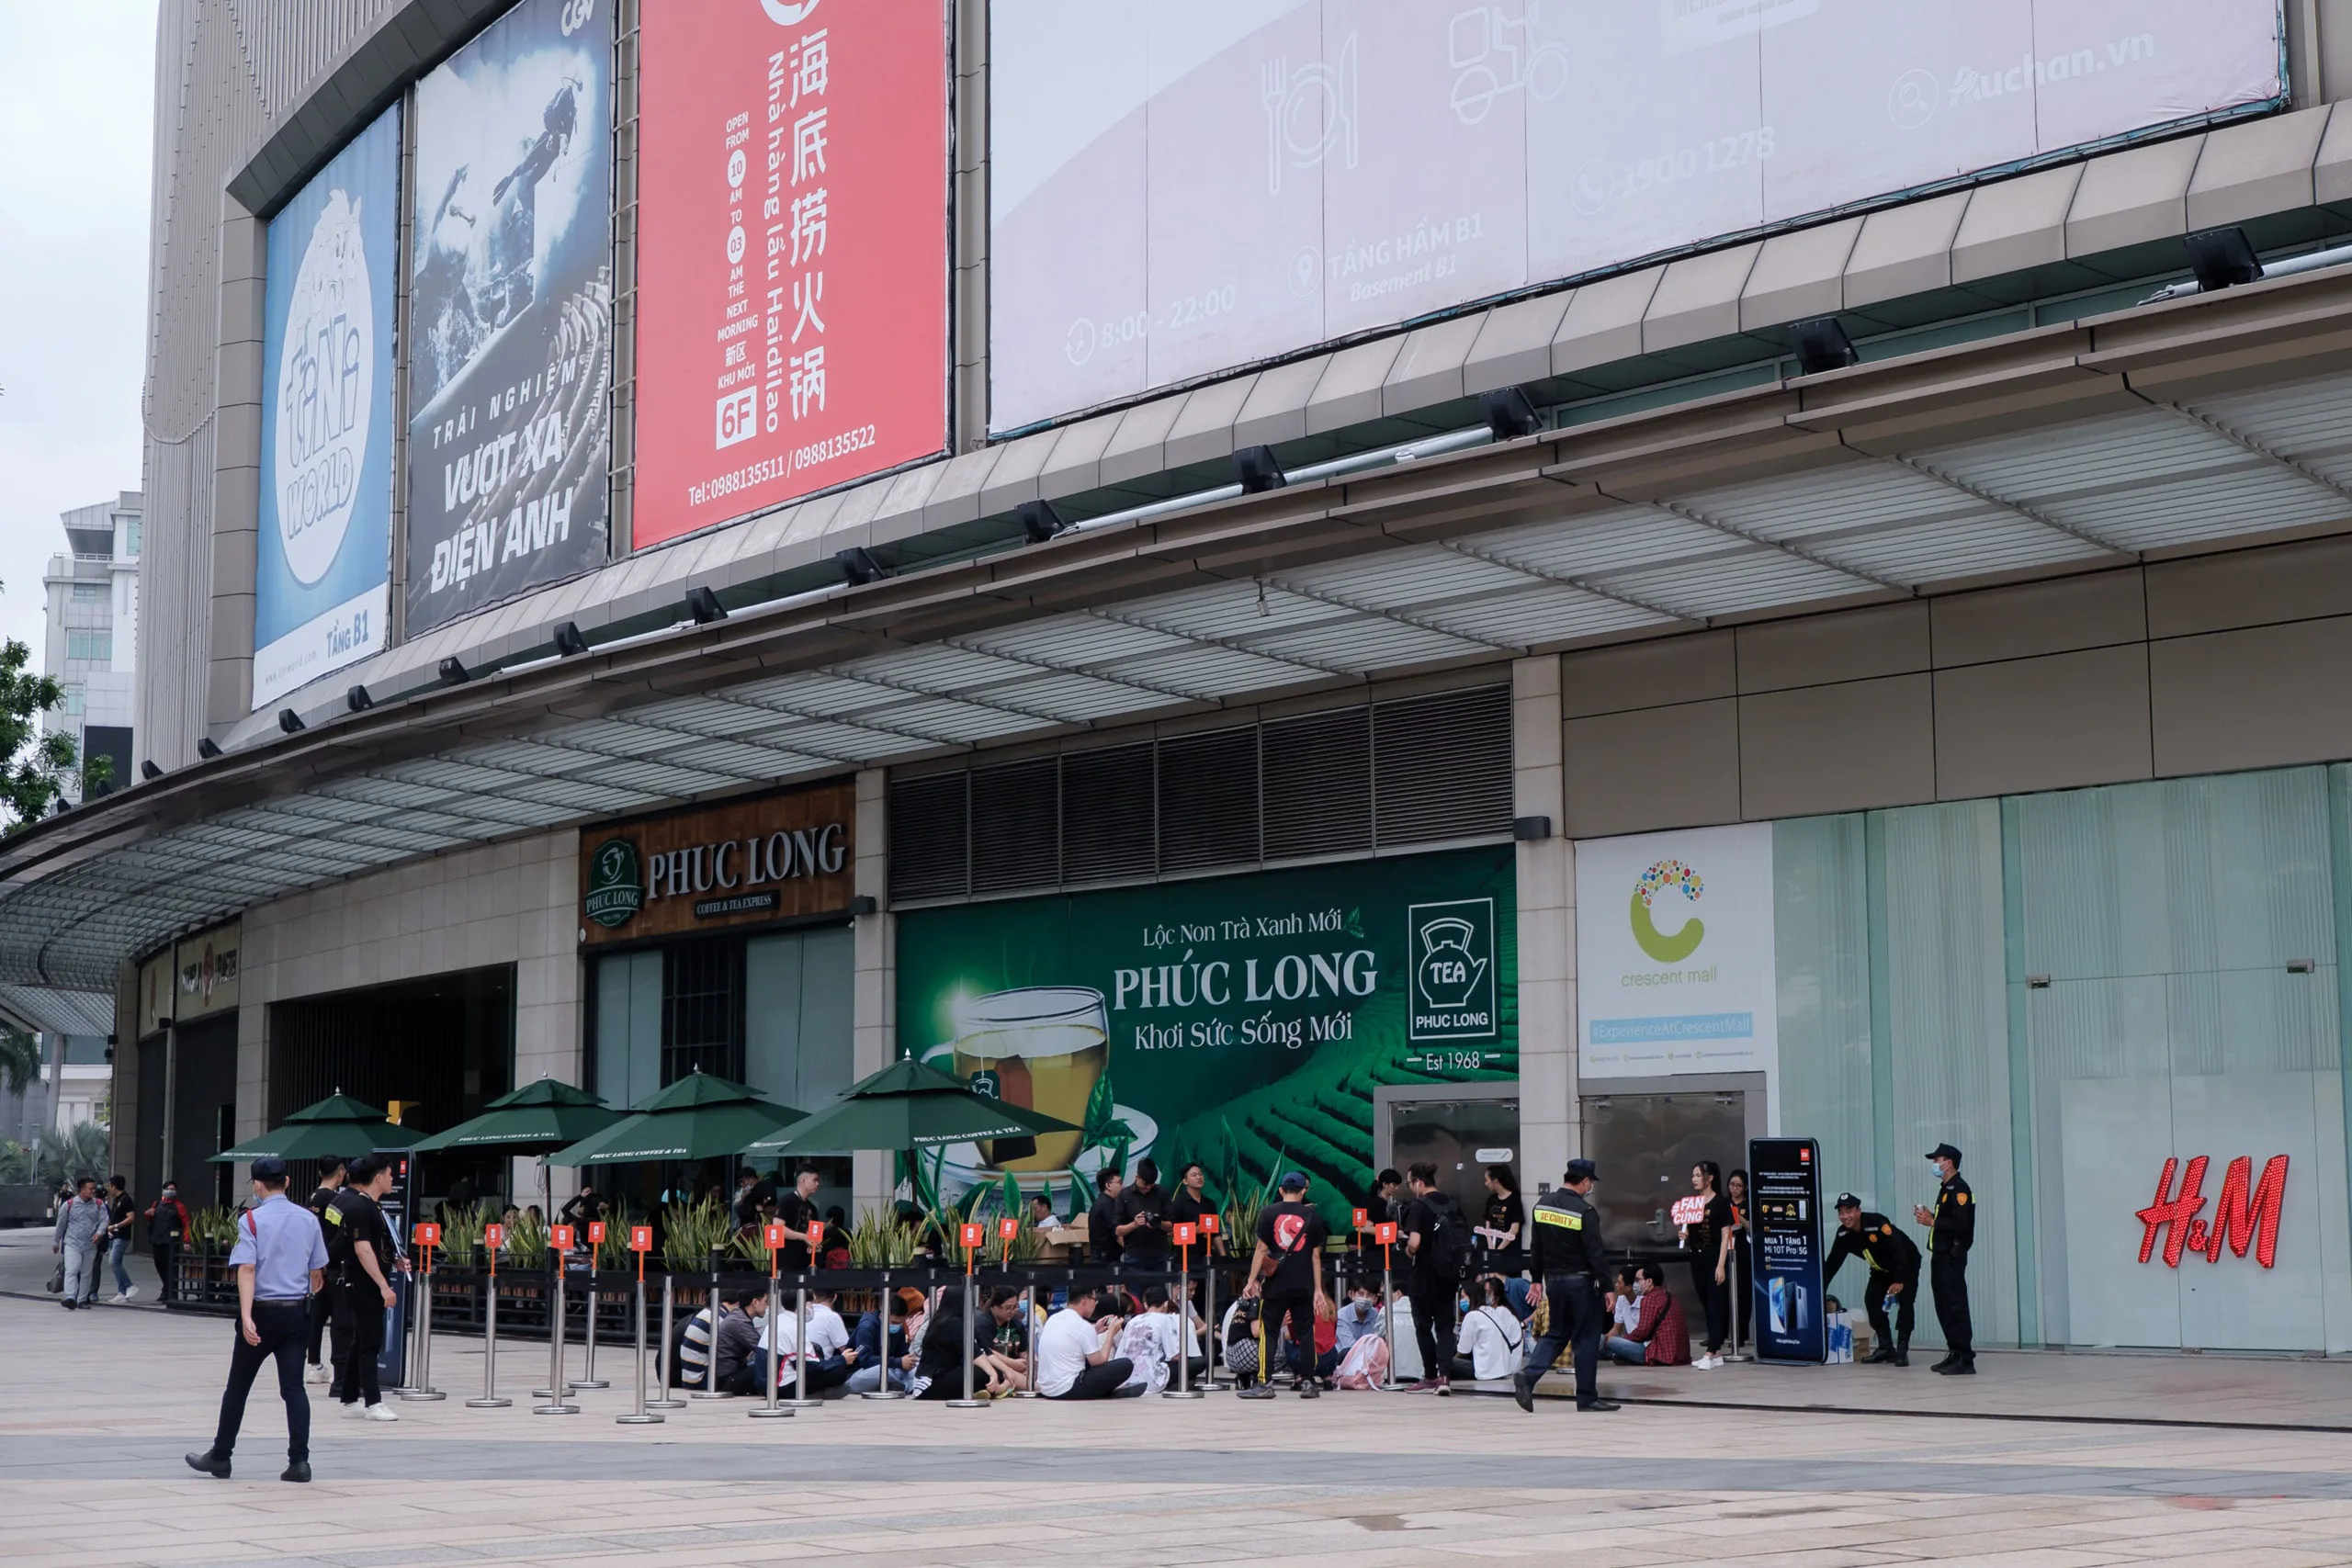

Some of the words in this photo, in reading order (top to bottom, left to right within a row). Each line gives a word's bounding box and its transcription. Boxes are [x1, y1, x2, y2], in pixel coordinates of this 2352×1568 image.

[561, 0, 594, 37] CGV
[768, 51, 786, 123] Nhà
[1948, 32, 2154, 109] Auchan.vn
[726, 111, 749, 133] OPEN
[725, 128, 750, 151] FROM
[730, 160, 743, 178] 10
[764, 127, 786, 220] hàng
[1621, 149, 1697, 198] 1900
[1702, 125, 1776, 173] 1278
[729, 187, 742, 206] AM
[730, 208, 742, 224] TO
[789, 28, 829, 422] 海底捞火锅
[730, 235, 742, 254] 03
[1329, 238, 1391, 281] TẦNG
[1396, 216, 1451, 261] HẦM
[1454, 213, 1484, 243] B1
[729, 264, 743, 282] AM
[1350, 264, 1430, 303] Basement
[1435, 254, 1457, 280] B1
[728, 281, 745, 299] THE
[726, 299, 749, 320] NEXT
[1101, 310, 1148, 349] 8:00
[1170, 284, 1237, 331] 22:00
[717, 313, 759, 343] MORNING
[725, 341, 747, 367] 新区
[766, 287, 783, 434] Haidilao
[718, 369, 735, 391] KHU
[433, 413, 477, 450] TRẢI
[489, 354, 578, 419] NGHIỆM
[721, 393, 752, 440] 6F
[444, 429, 518, 513] VƯỢT
[519, 411, 568, 479] XA
[794, 424, 876, 472] 0988135522
[287, 446, 355, 540] WORLD
[430, 518, 498, 594] ĐIỆN
[502, 486, 576, 565] ẢNH
[353, 609, 369, 648] B1
[647, 840, 737, 900] PHUC
[747, 823, 846, 886] LONG
[613, 889, 639, 906] LONG
[696, 901, 721, 915] COFFEE
[722, 900, 729, 911] &
[729, 898, 741, 910] TEA
[742, 895, 772, 908] EXPRESS
[1143, 924, 1175, 949] Lộc
[1180, 922, 1216, 943] Non
[1220, 919, 1250, 941] Trà
[1255, 912, 1303, 937] Xanh
[1307, 908, 1342, 932] Mới
[1113, 948, 1230, 1011] PHÚC
[1244, 949, 1379, 1003] LONG
[1430, 960, 1466, 985] TEA
[1621, 968, 1683, 987] crescent
[1688, 965, 1717, 983] mall
[1135, 1023, 1183, 1051] Khơi
[1190, 1018, 1234, 1048] Sức
[1240, 1010, 1303, 1050] Sống
[1309, 1011, 1353, 1043] Mới
[1415, 1014, 1450, 1029] PHUC
[1453, 1011, 1489, 1027] LONG
[1426, 1055, 1443, 1071] Est
[1448, 1051, 1480, 1070] 1968
[1003, 1126, 1022, 1134] TEA
[1540, 1212, 1574, 1227] SECURITY
[2134, 1154, 2290, 1269] H&M
[1764, 1236, 1778, 1245] MUA
[1764, 1246, 1772, 1254] Mi
[1773, 1246, 1784, 1255] 10T
[1785, 1246, 1797, 1255] Pro
[1798, 1246, 1808, 1256] 5G
